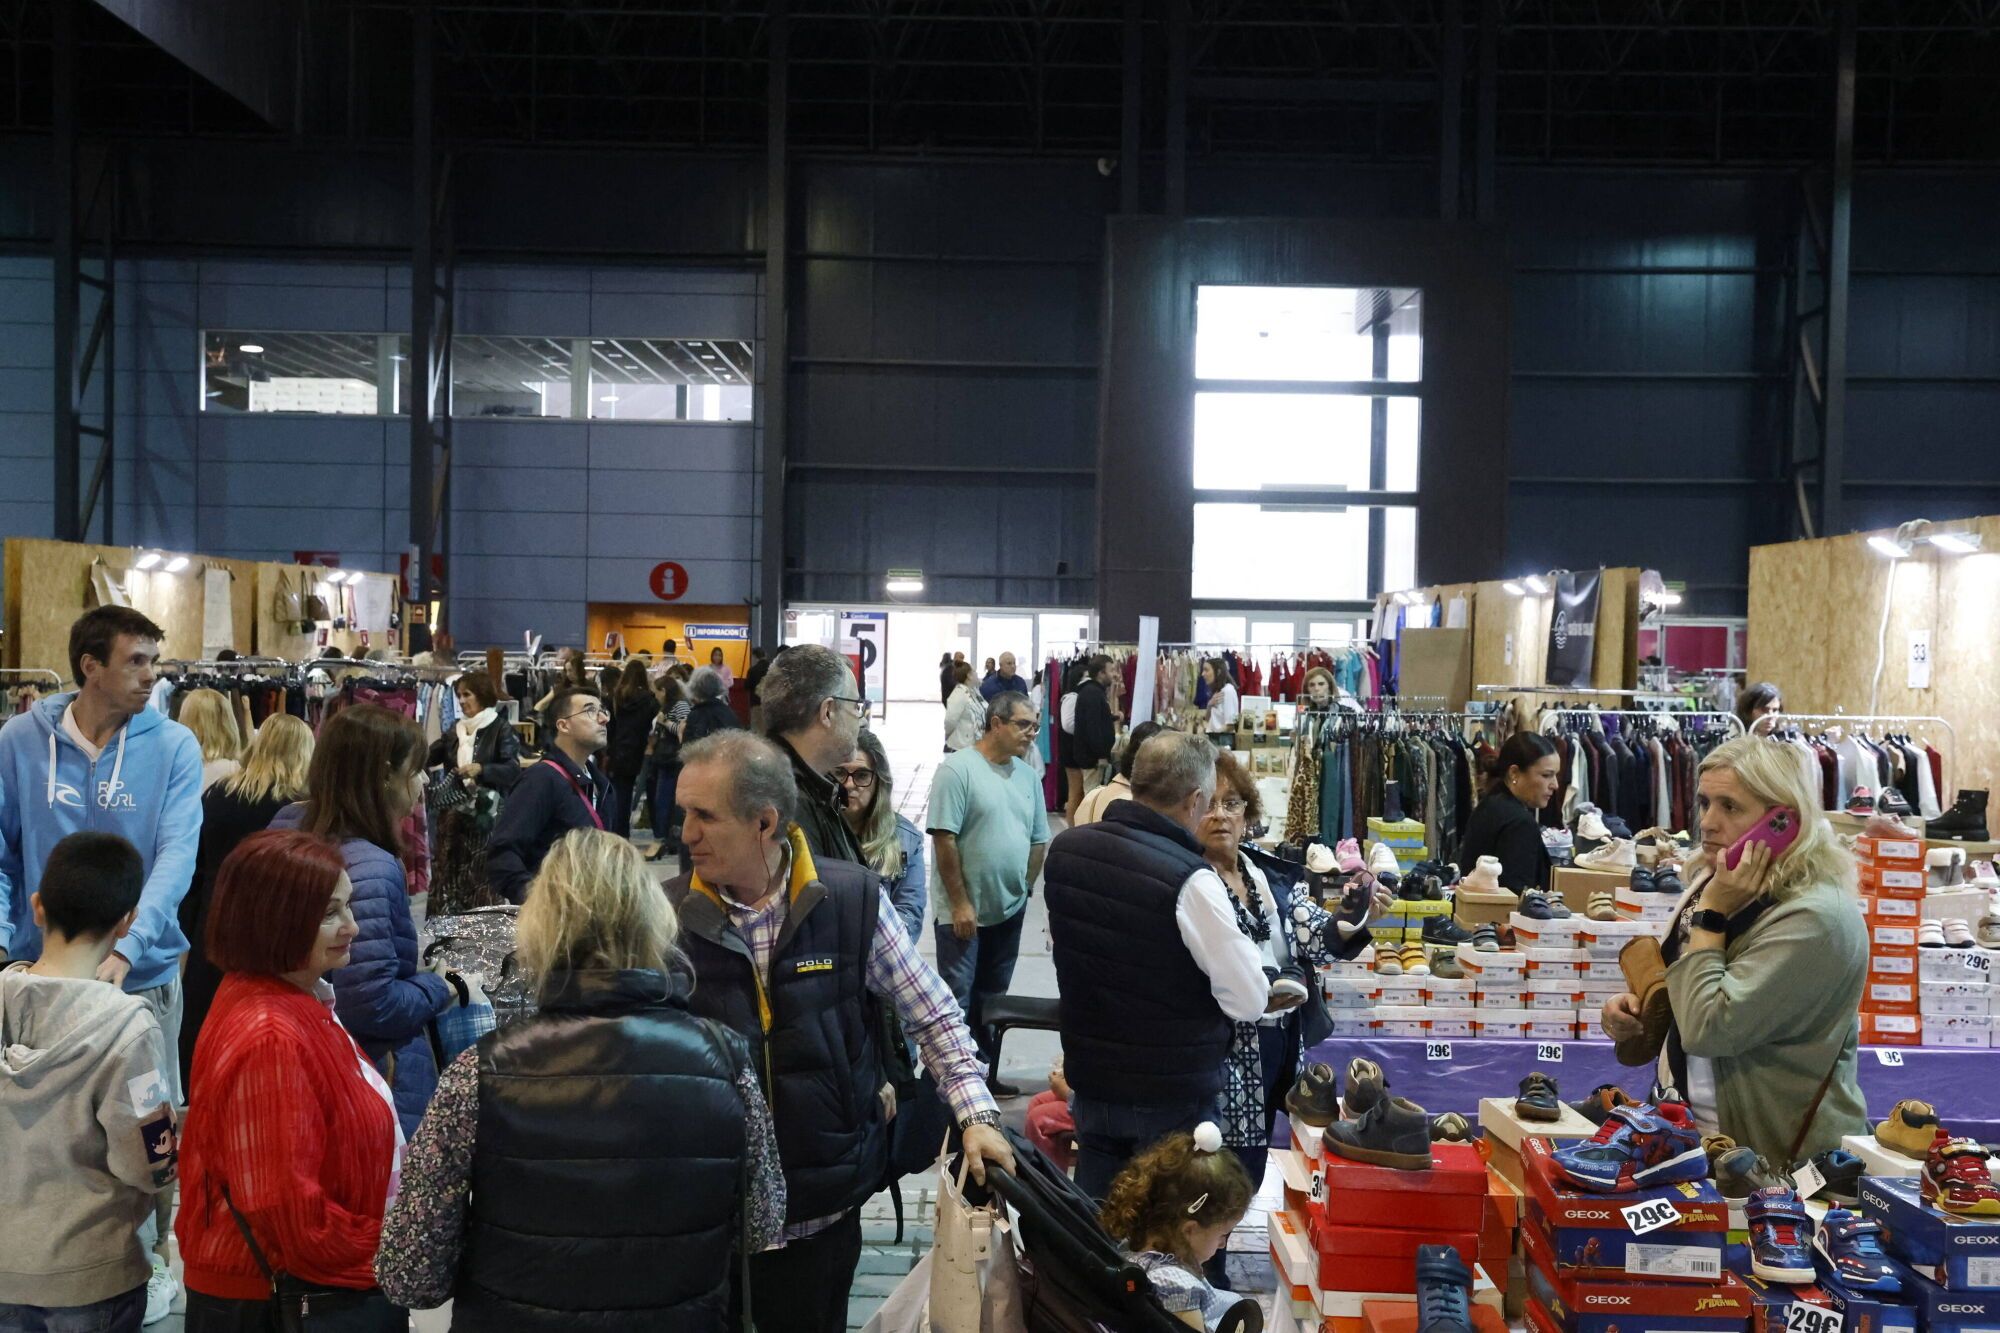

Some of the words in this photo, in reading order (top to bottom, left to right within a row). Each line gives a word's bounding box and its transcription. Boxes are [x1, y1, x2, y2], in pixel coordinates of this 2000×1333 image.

[849, 623, 877, 669] 5
[98, 781, 125, 794] RP
[796, 958, 832, 967] POLO
[1427, 1044, 1450, 1058] 29€
[1538, 1045, 1561, 1059] 29€
[1763, 1202, 1792, 1210] GEOX
[1862, 1190, 1890, 1214] GEOX
[1564, 1210, 1610, 1219] GEOX
[1626, 1202, 1676, 1231] 29€
[1954, 1236, 2000, 1245] GEOX
[1585, 1295, 1631, 1305] GEOX
[1937, 1304, 1985, 1314] GEOX
[1789, 1306, 1840, 1333] 29€
